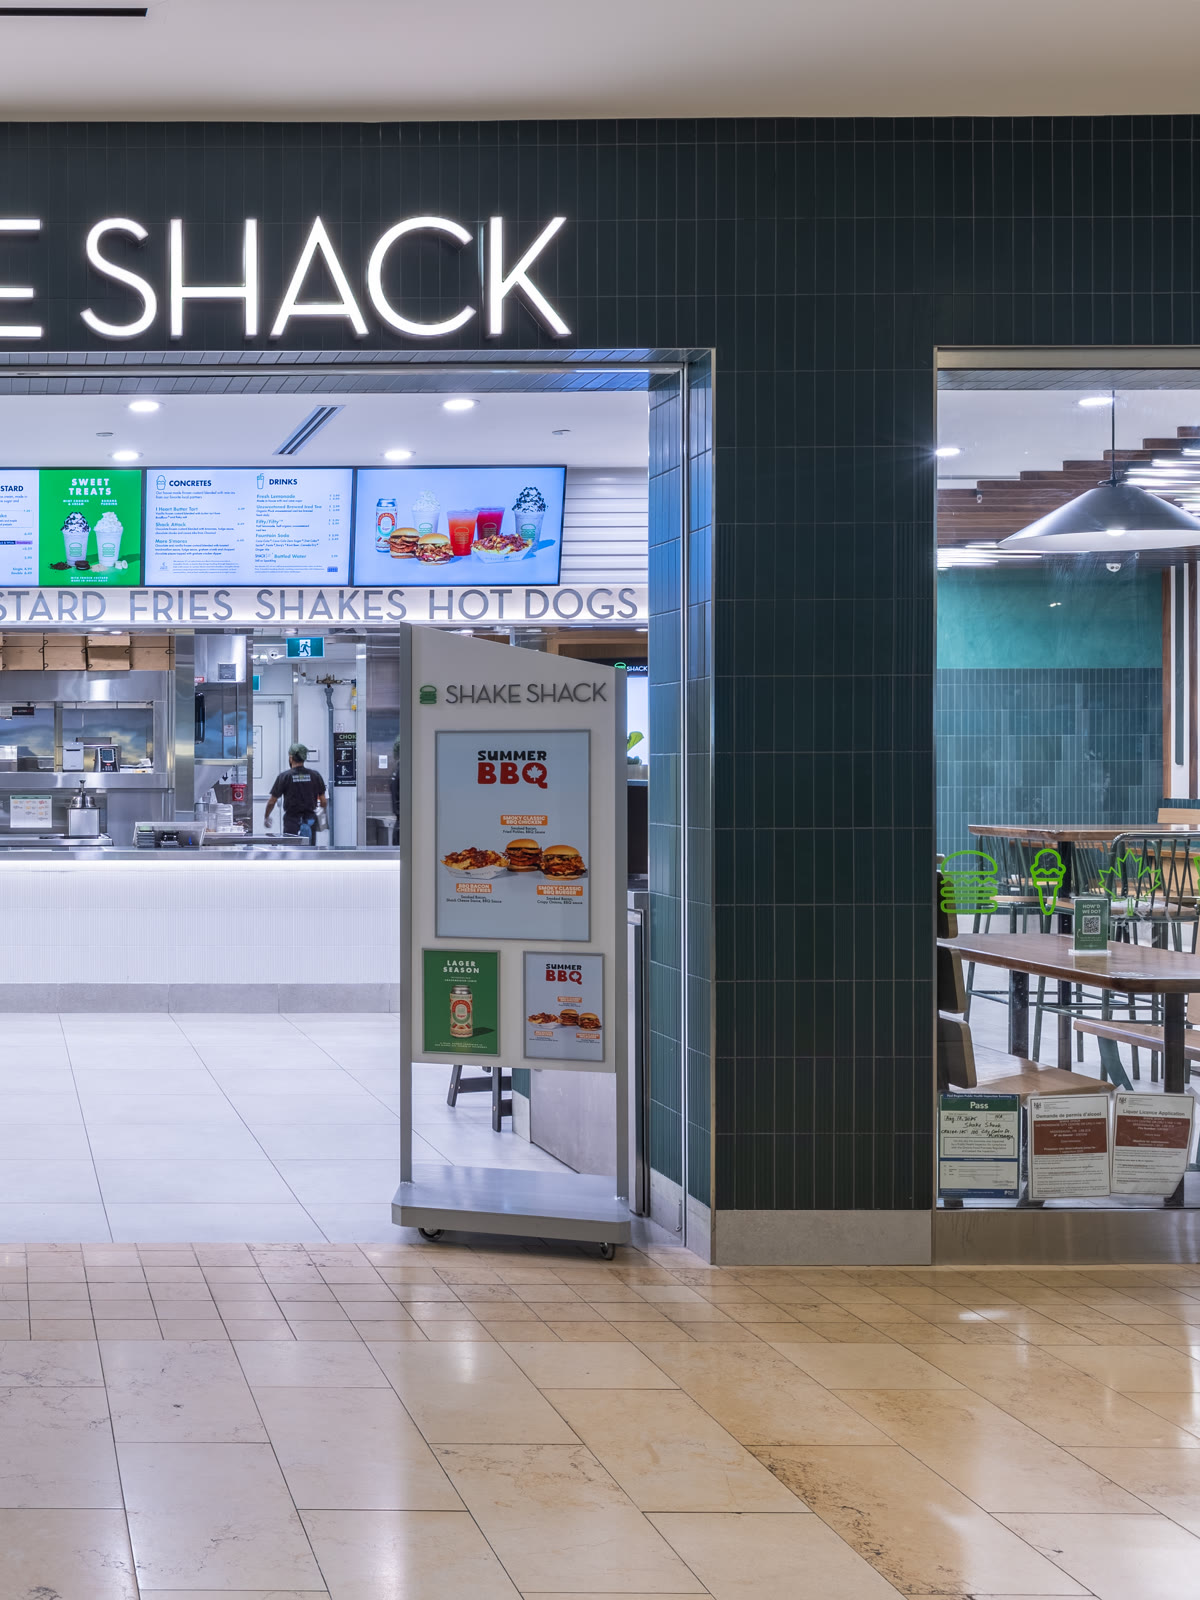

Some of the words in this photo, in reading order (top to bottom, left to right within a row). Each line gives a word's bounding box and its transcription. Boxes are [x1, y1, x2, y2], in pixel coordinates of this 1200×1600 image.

[80, 216, 572, 339] SHACK
[130, 590, 233, 621] FRIES
[255, 589, 407, 621] SHAKES
[429, 589, 512, 620] HOT
[525, 588, 638, 620] DOGS
[446, 684, 522, 704] SHAKE
[526, 682, 607, 703] SHACK
[478, 750, 547, 760] SUMMER
[478, 762, 548, 789] BBQ
[546, 970, 582, 985] BBQ
